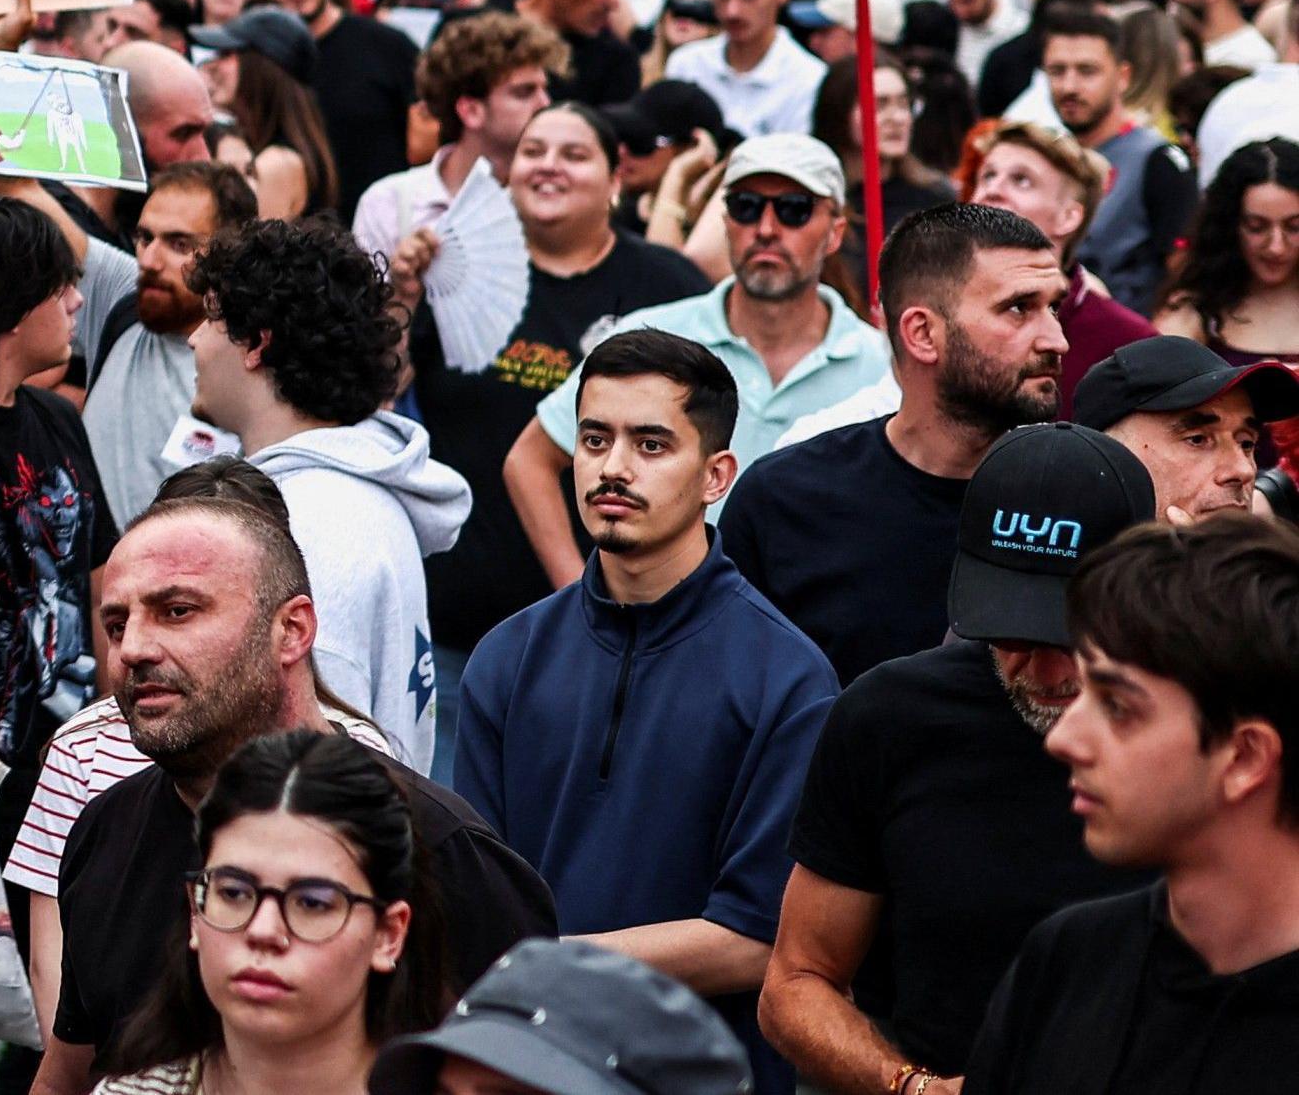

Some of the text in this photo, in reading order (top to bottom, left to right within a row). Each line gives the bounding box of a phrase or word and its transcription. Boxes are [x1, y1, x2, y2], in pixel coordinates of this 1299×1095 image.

[991, 539, 1079, 559] UNLEASH YOUR NATURE
